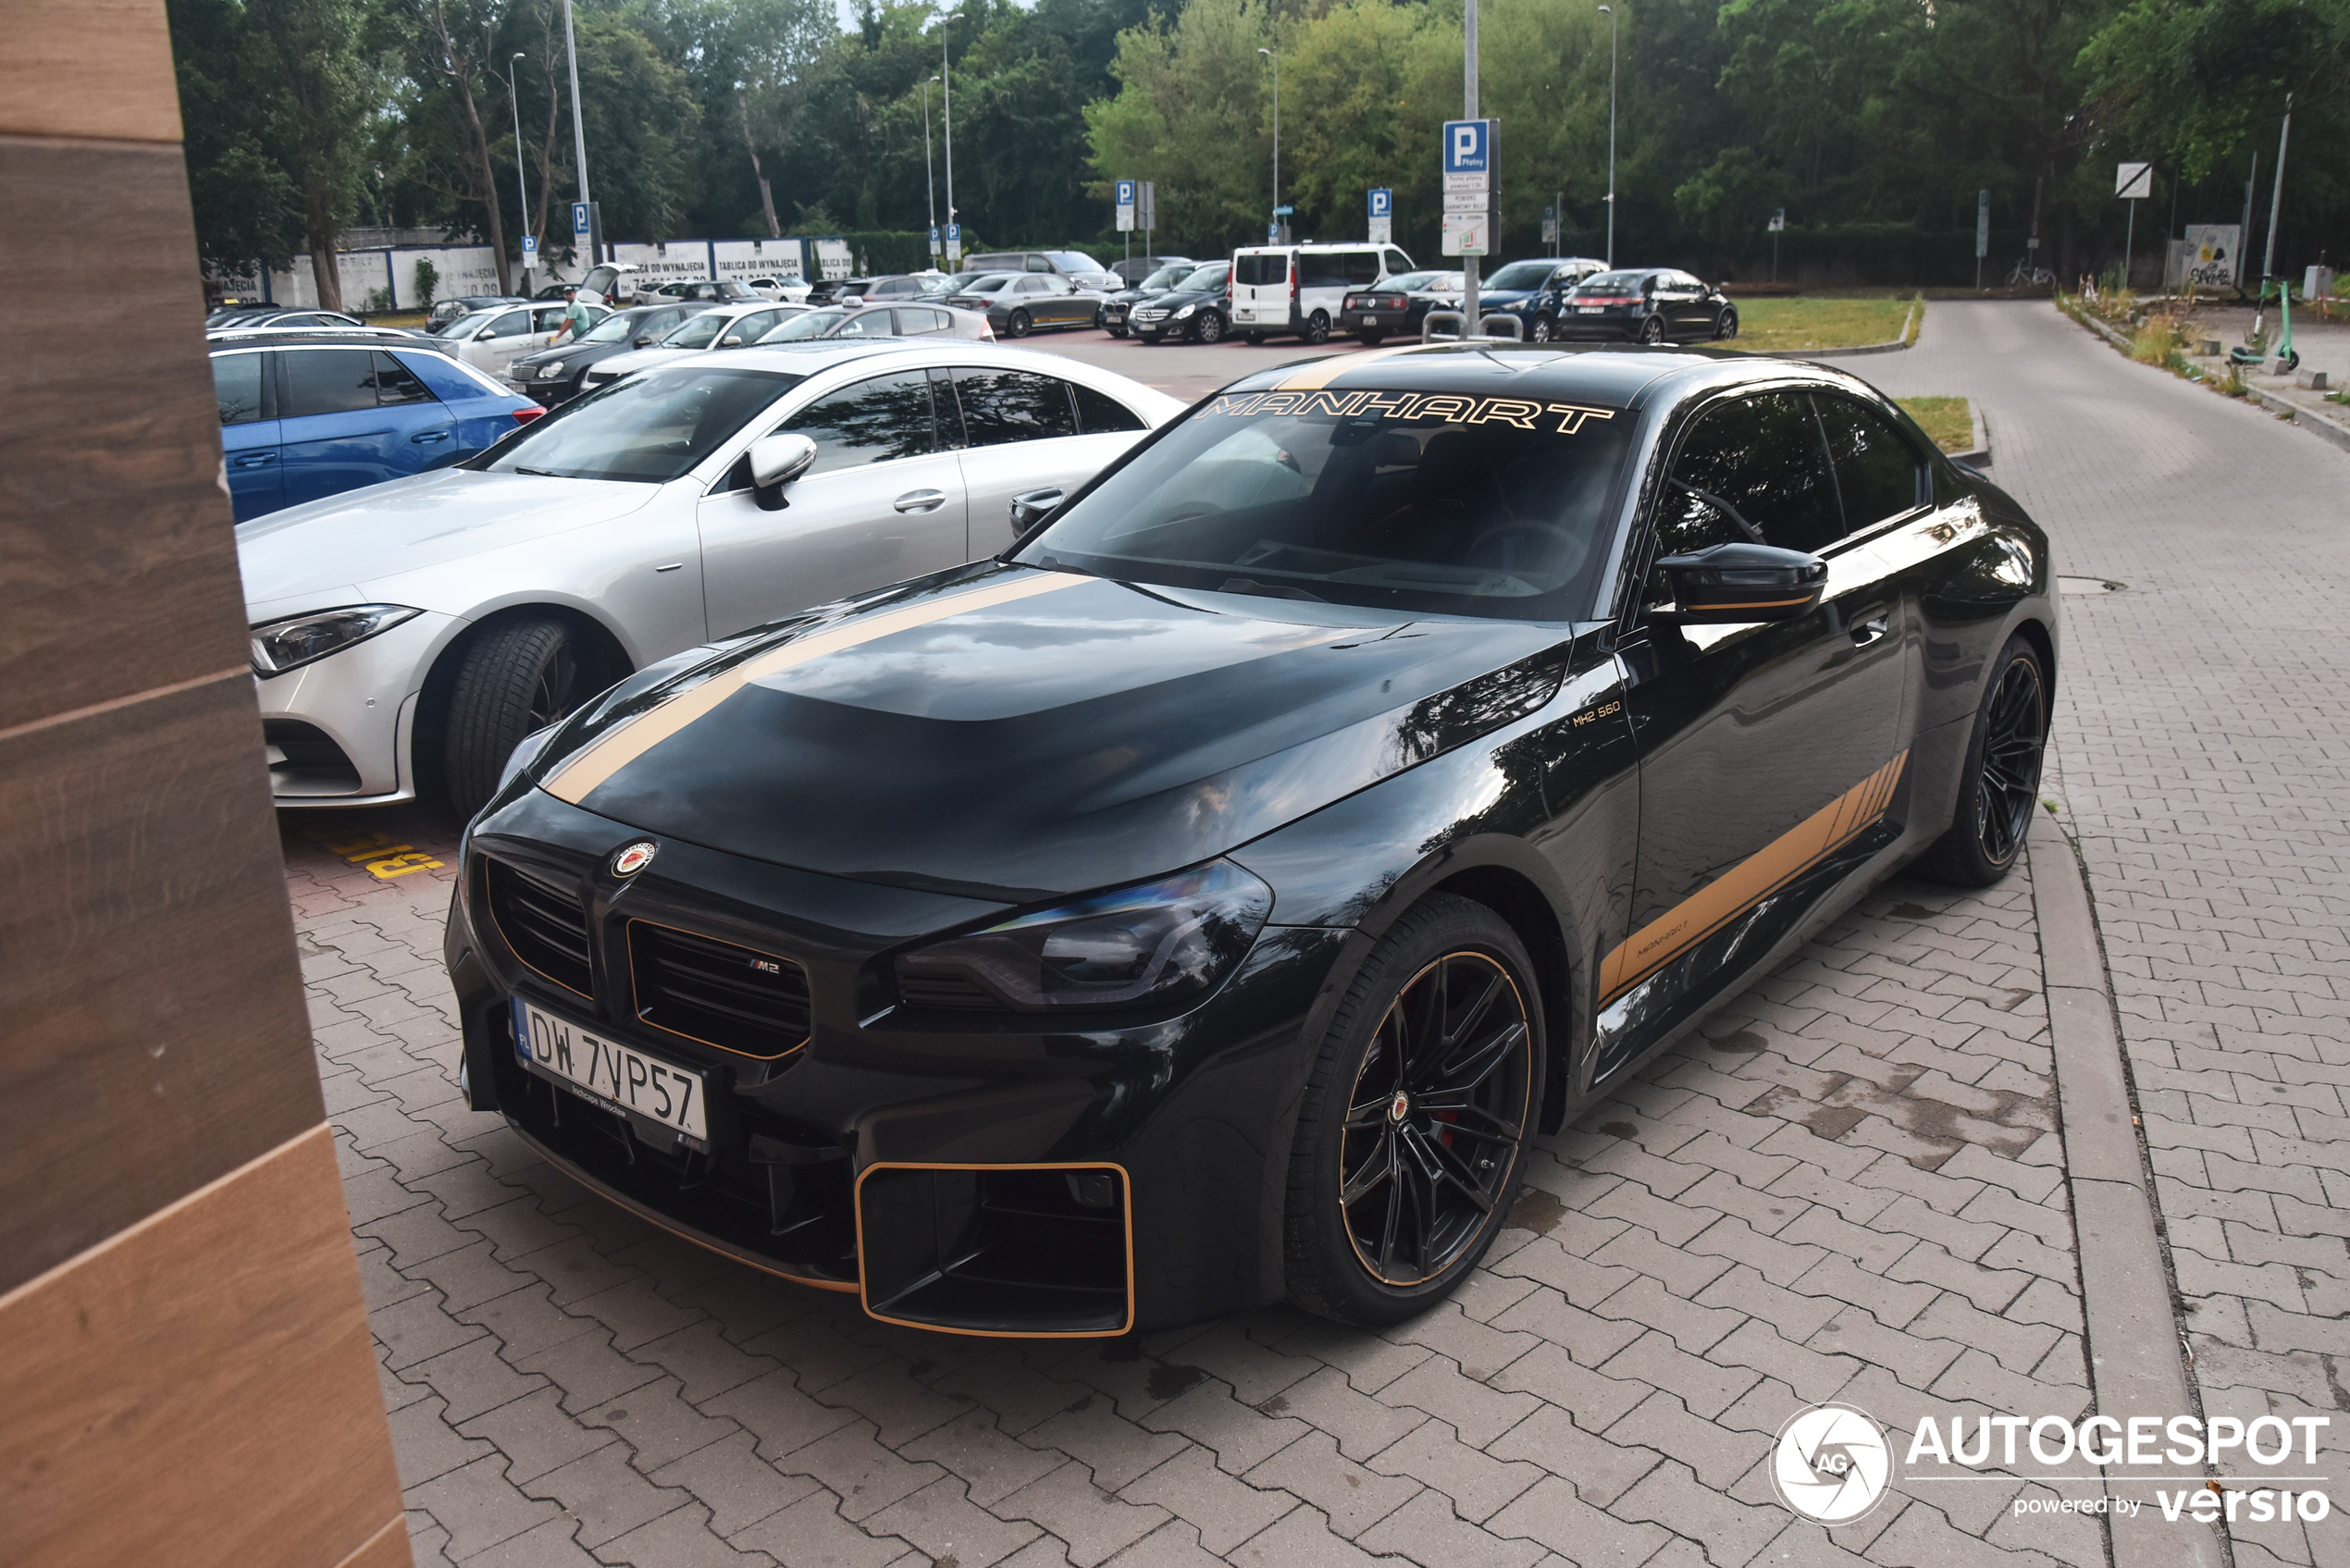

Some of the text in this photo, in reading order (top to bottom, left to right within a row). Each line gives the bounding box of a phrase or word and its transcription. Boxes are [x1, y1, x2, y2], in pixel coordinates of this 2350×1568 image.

[1454, 127, 1477, 167] P
[1119, 184, 1131, 204] P
[1373, 192, 1387, 216] P
[576, 206, 587, 230] P
[932, 229, 938, 241] P
[949, 226, 957, 239] P
[525, 238, 534, 251] P
[651, 263, 662, 274] DO
[662, 262, 705, 274] WYNAJĘCIA
[719, 259, 798, 271] TABLICA DO WYNAJĘCIA
[1194, 391, 1615, 435] MANHART
[1573, 700, 1621, 728] MH2 560
[1637, 919, 1689, 958] MANHART
[758, 960, 780, 974] M2
[519, 1032, 530, 1050] PL
[531, 1010, 693, 1127] DW 7VP57
